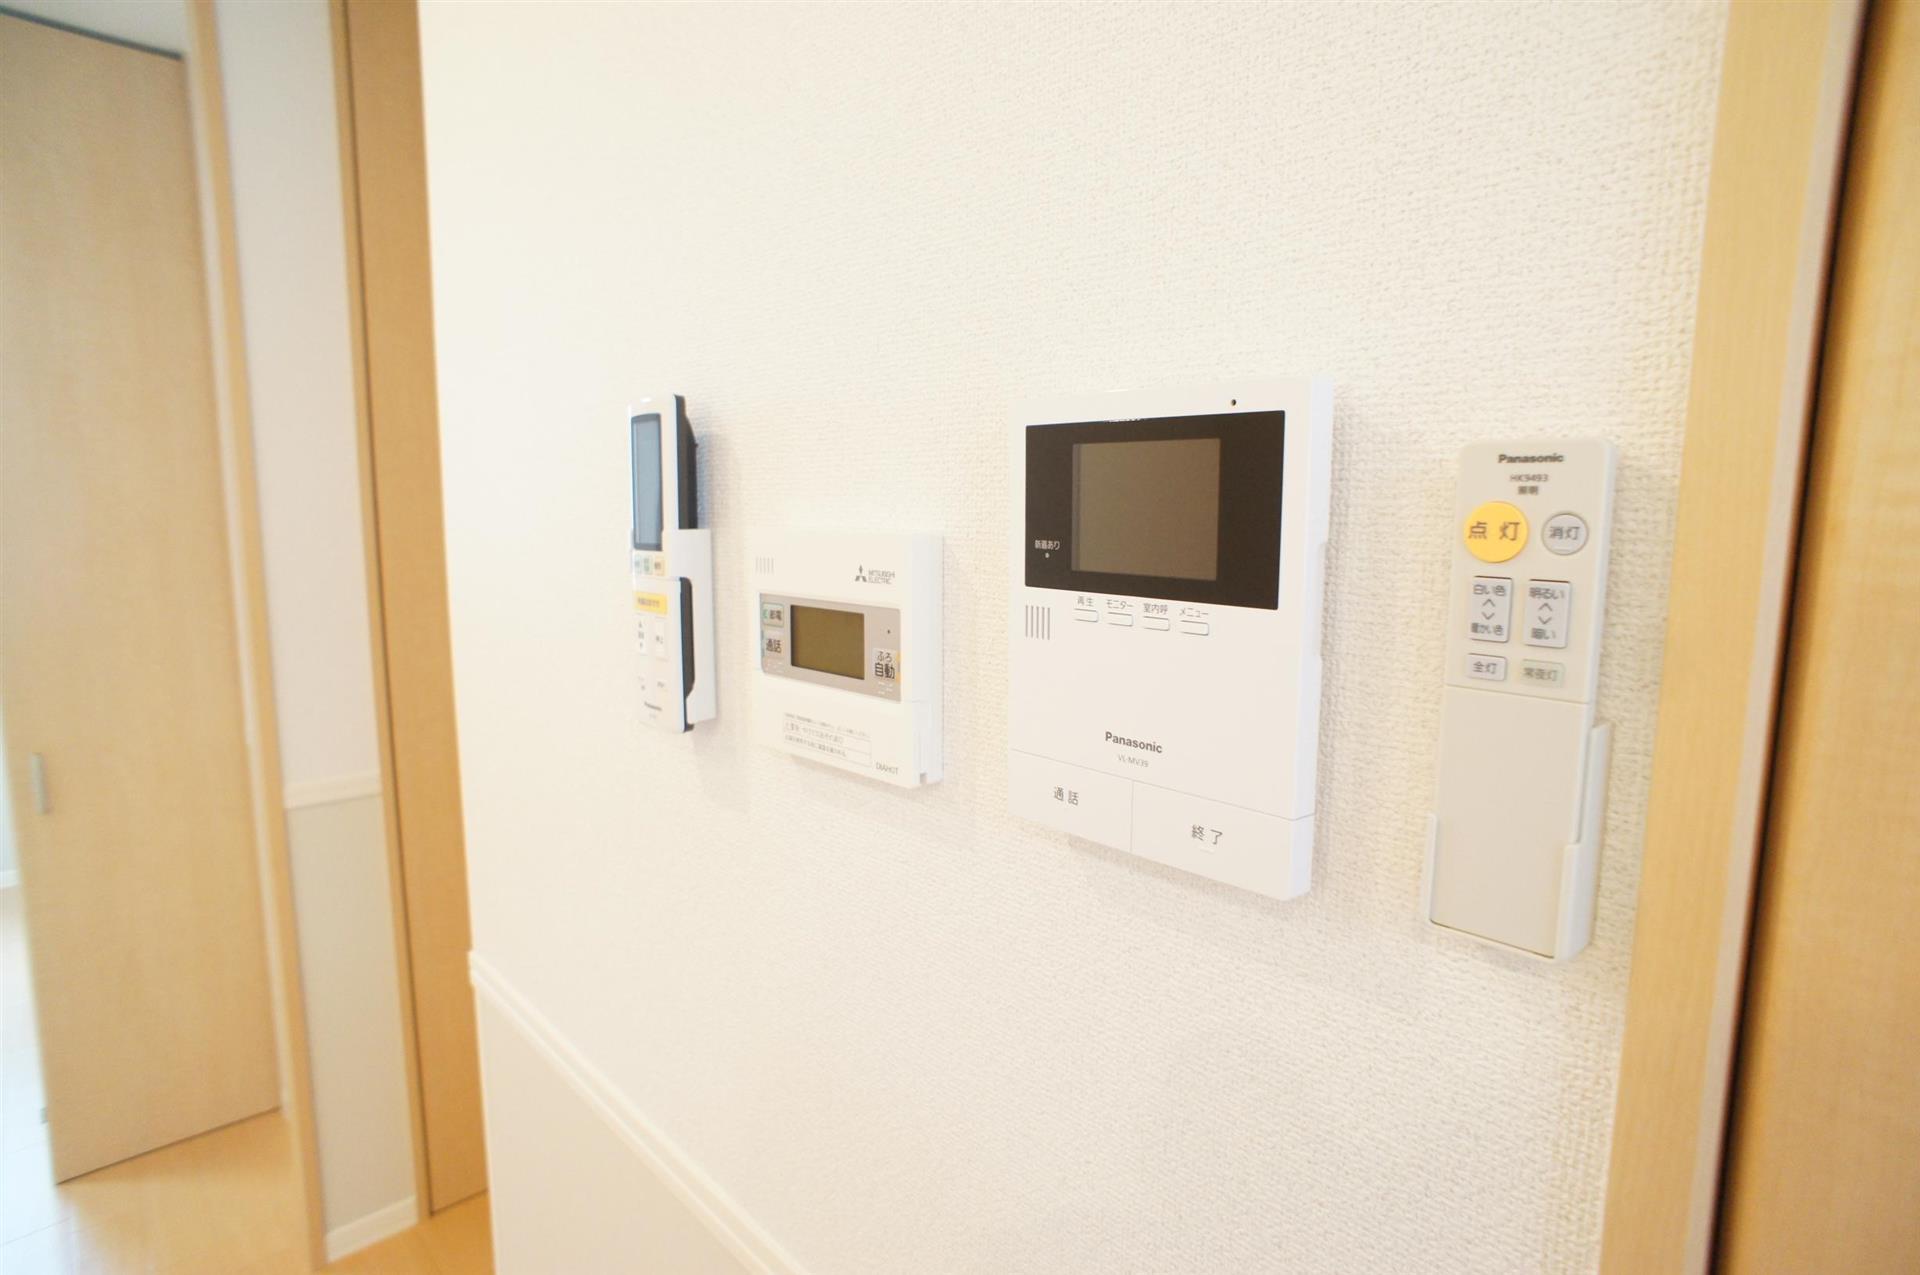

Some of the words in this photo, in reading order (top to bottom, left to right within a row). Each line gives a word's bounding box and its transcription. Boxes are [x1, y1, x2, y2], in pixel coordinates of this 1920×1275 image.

[1498, 453, 1565, 464] Panasonic
[1549, 526, 1580, 541] 消灯
[1034, 539, 1060, 550] 新着あり
[868, 569, 896, 579] MITSUBISHI
[868, 576, 891, 585] ELECTRIC
[1473, 583, 1507, 596] 白い色
[1529, 587, 1565, 600] 明るい
[1077, 597, 1094, 607] 再生
[1106, 600, 1134, 610] モニター
[1143, 603, 1168, 614] 室内呼
[1179, 607, 1209, 618] メニュー
[765, 638, 782, 654] 通話
[877, 651, 893, 662] ふろ
[874, 663, 896, 680] 自動
[1473, 661, 1498, 674] 全灯
[1523, 667, 1558, 682] 常夜灯
[1105, 731, 1163, 754] Panasonic
[1053, 786, 1079, 806] 通話
[1190, 824, 1224, 846] 終了
